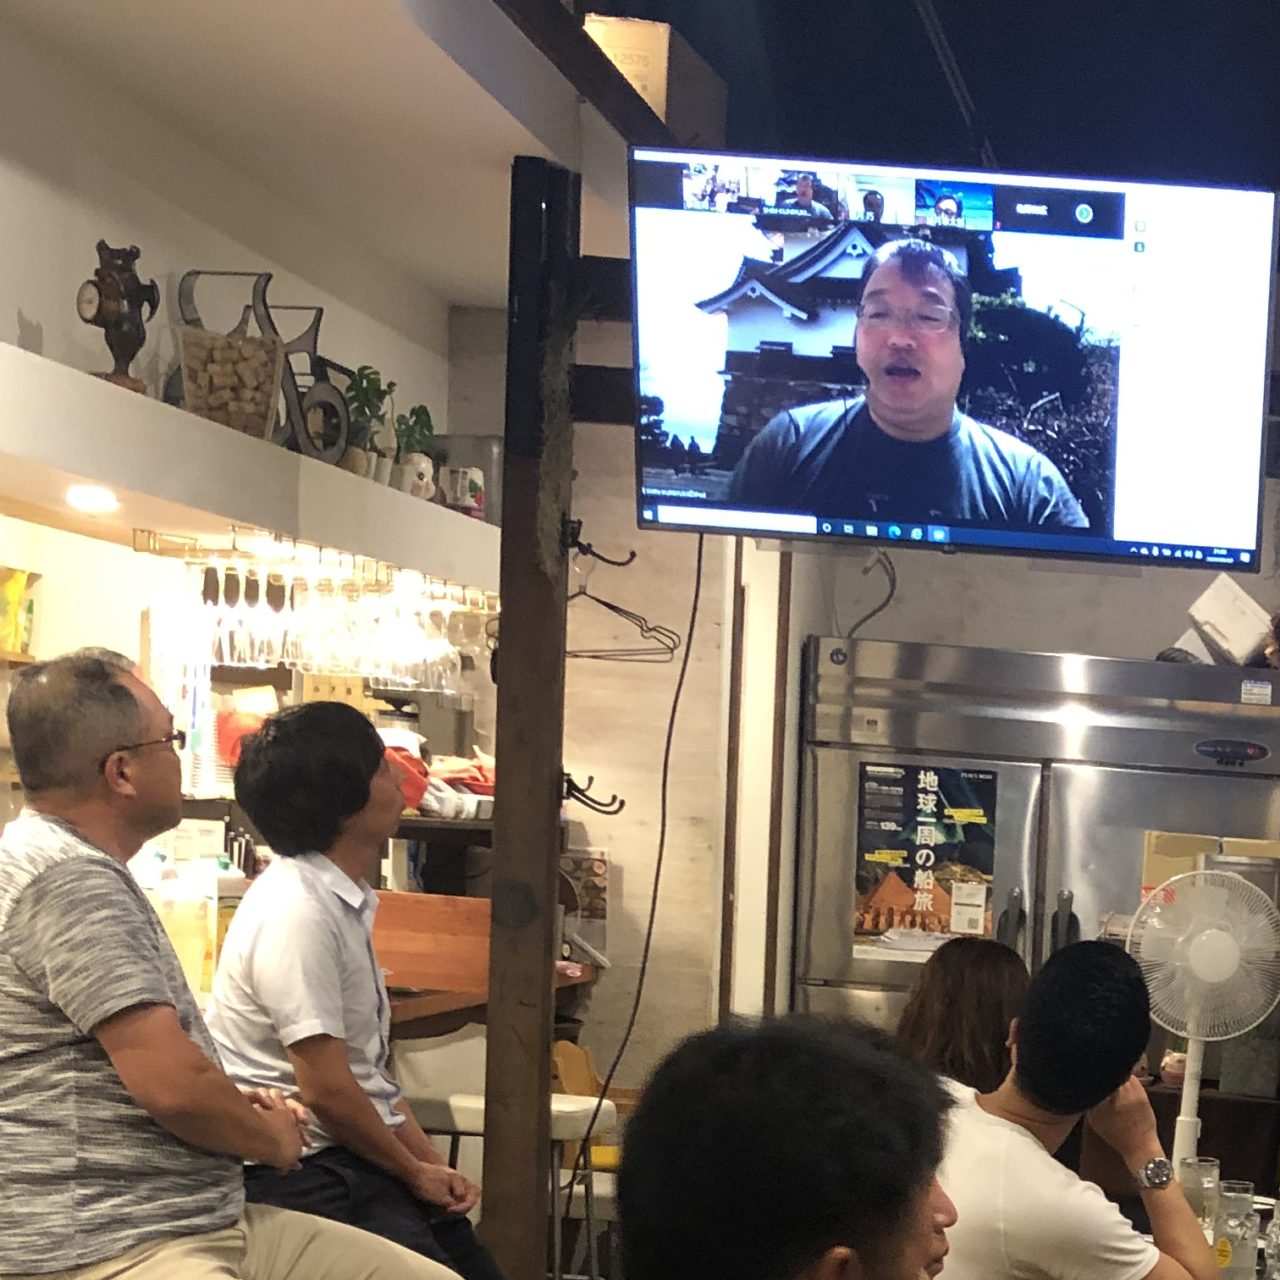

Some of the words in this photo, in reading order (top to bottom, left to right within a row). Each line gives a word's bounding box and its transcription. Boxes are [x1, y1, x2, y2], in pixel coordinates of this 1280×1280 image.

[914, 770, 938, 912] 地球一周の船旅
